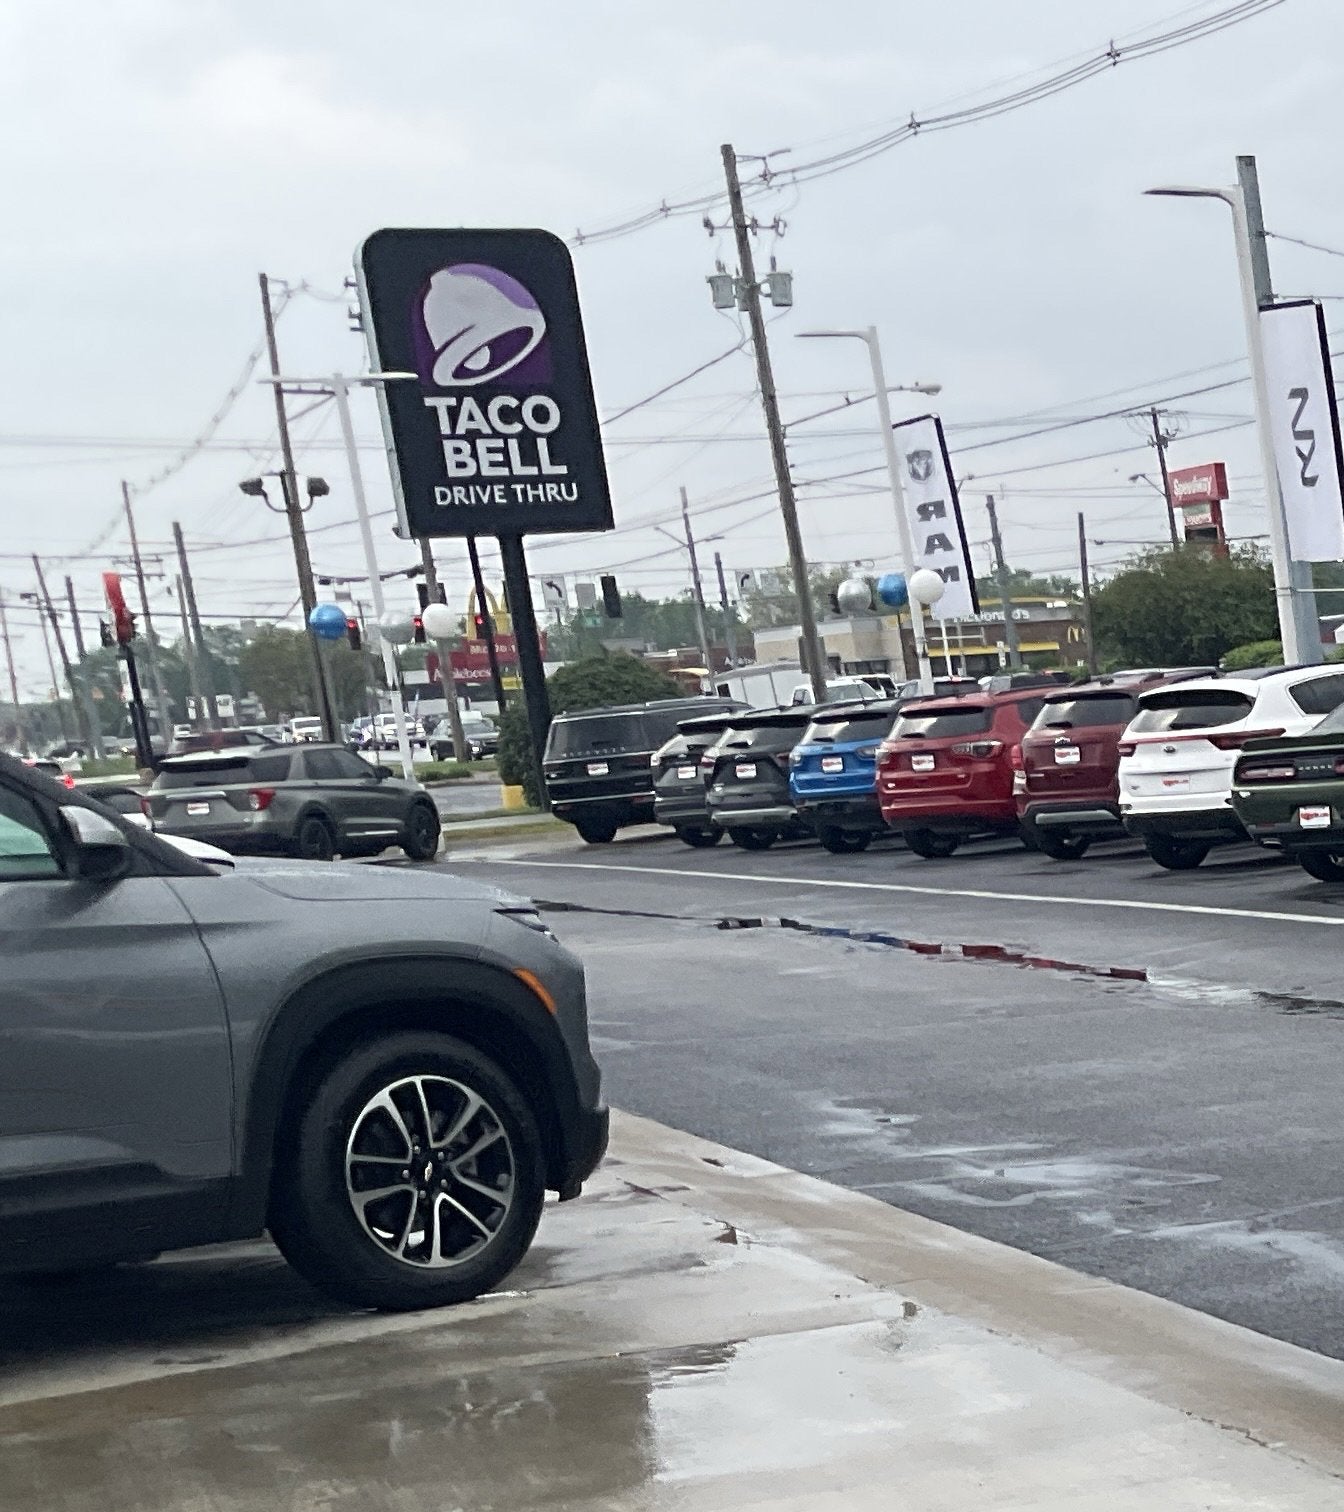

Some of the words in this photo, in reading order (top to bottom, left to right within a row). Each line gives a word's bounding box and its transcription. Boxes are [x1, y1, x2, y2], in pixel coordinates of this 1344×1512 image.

[423, 394, 561, 435] TACO
[442, 437, 569, 478] BELL
[434, 484, 507, 506] DRIVE
[511, 482, 579, 504] THRU
